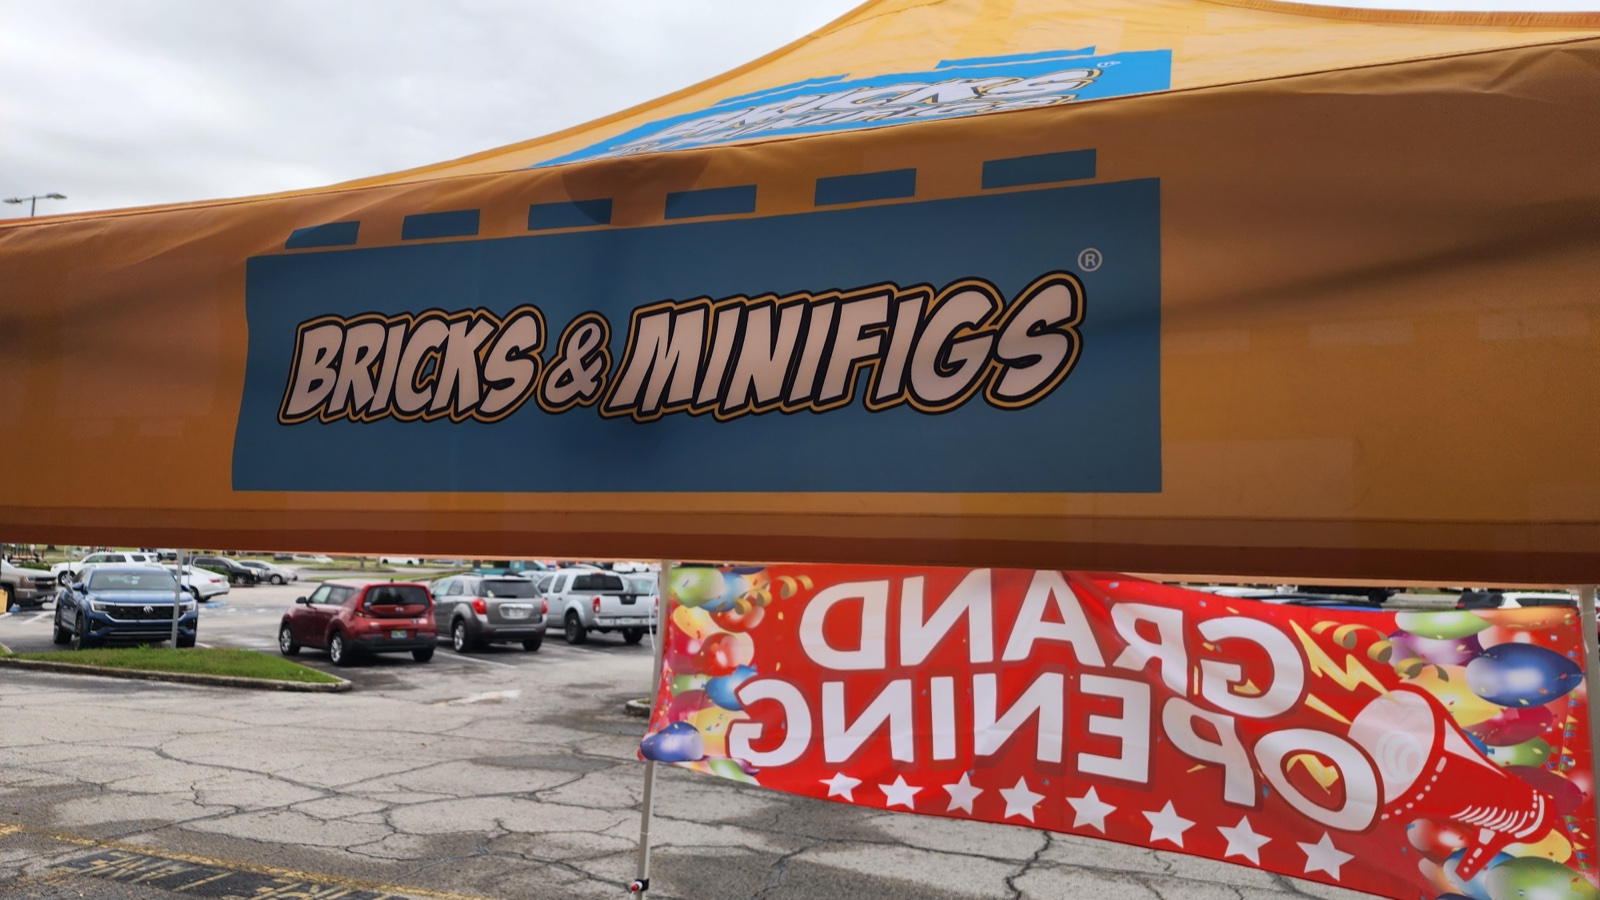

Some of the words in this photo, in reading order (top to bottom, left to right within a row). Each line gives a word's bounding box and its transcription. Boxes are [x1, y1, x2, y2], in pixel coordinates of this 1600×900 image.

[280, 307, 545, 424] BRICKS
[538, 311, 610, 412] &
[603, 272, 1085, 418] MINIFIGS
